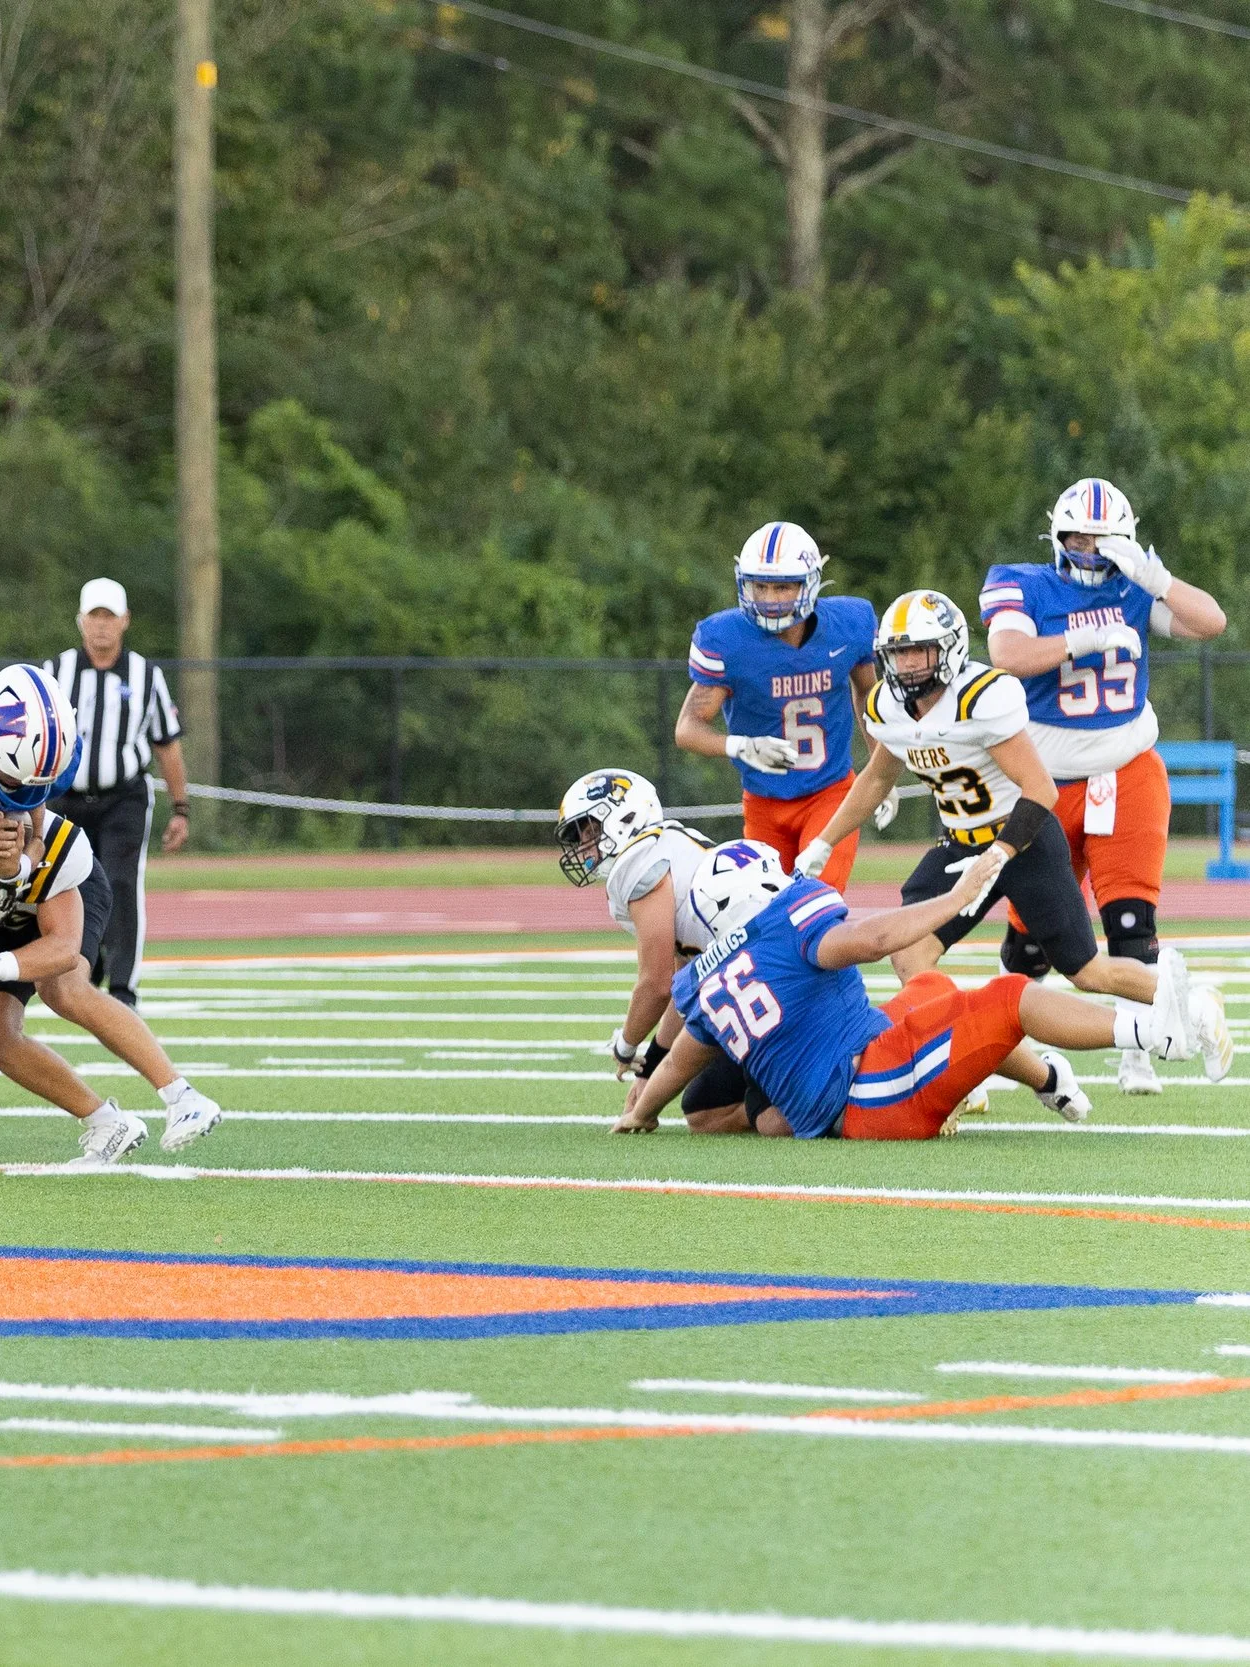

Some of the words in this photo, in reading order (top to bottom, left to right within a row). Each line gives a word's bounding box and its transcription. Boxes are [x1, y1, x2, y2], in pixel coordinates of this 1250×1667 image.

[771, 669, 832, 697] BRUINS
[1058, 648, 1137, 717] 55
[781, 696, 827, 770] 6
[906, 746, 951, 769] NEERS
[915, 766, 994, 817] 23
[716, 841, 761, 870] N
[694, 927, 749, 983] RIDINGS
[699, 951, 783, 1062] 56
